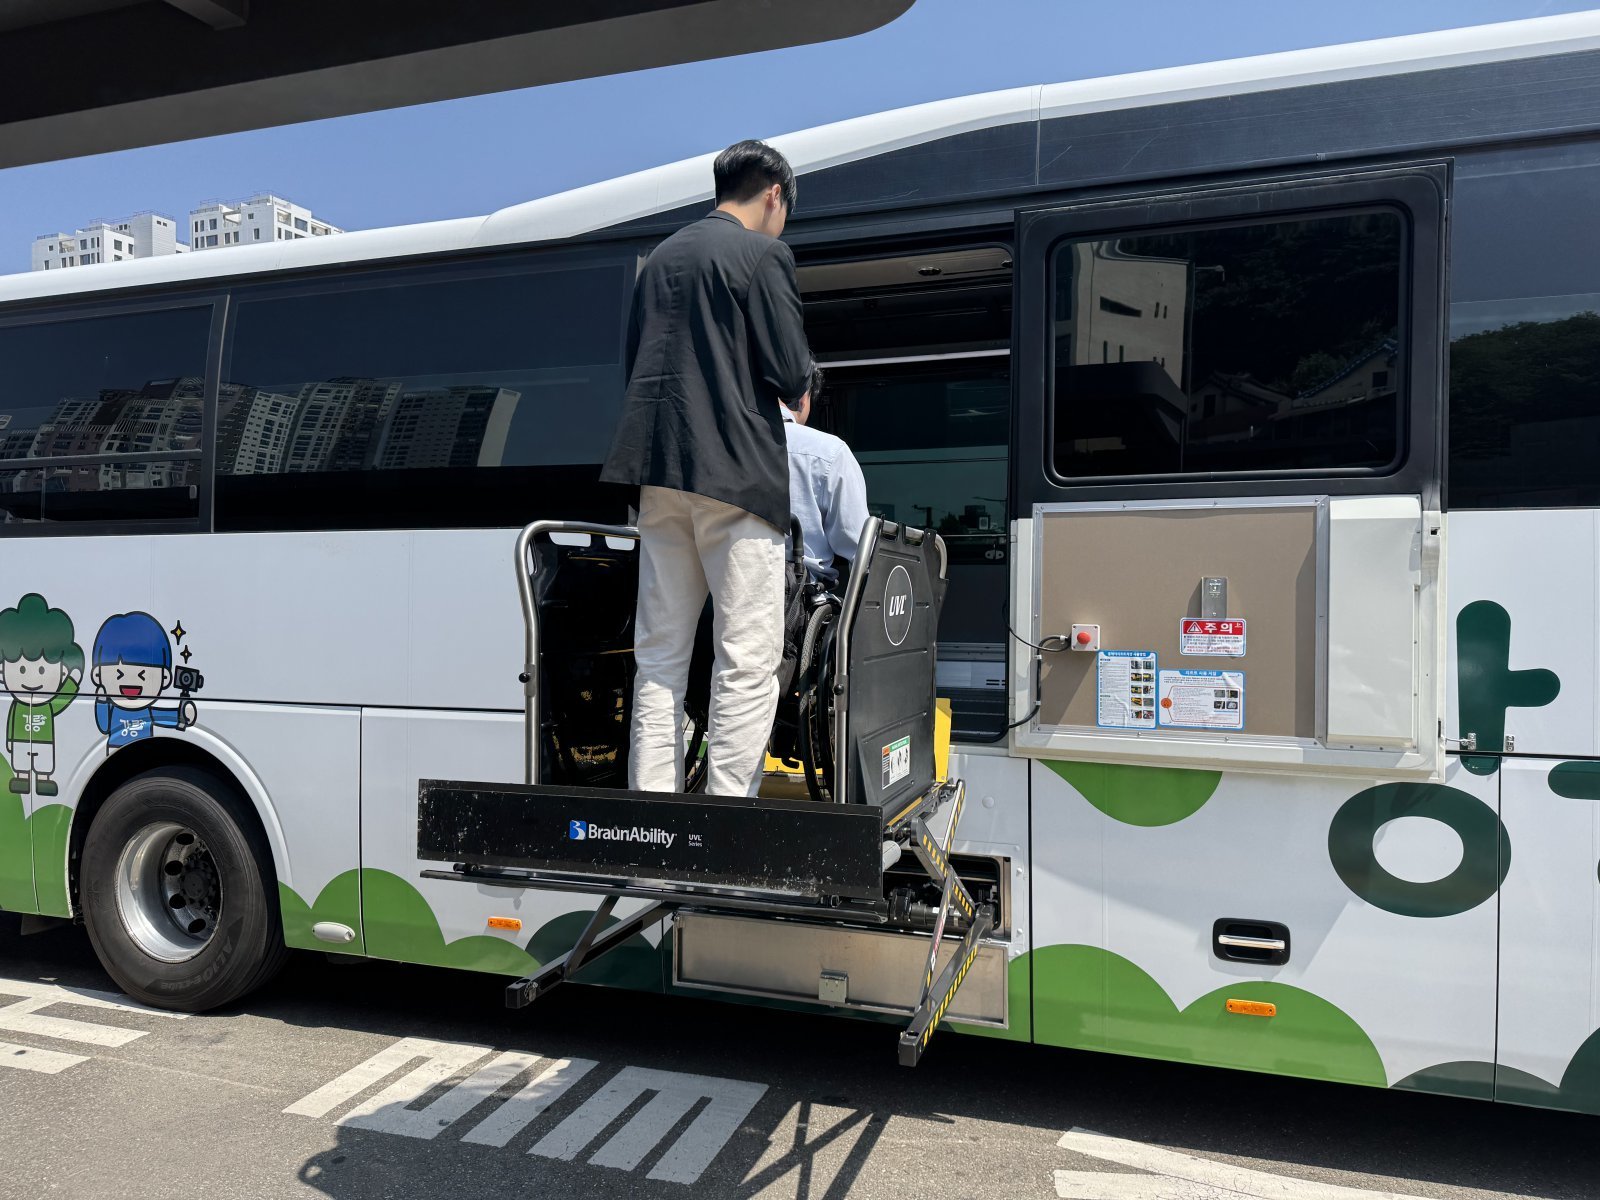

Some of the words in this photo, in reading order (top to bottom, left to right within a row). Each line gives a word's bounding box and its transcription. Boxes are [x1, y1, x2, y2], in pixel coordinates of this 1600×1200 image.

[1204, 622, 1233, 634] 주의
[588, 823, 676, 848] BraunAbility
[688, 833, 702, 841] UVL
